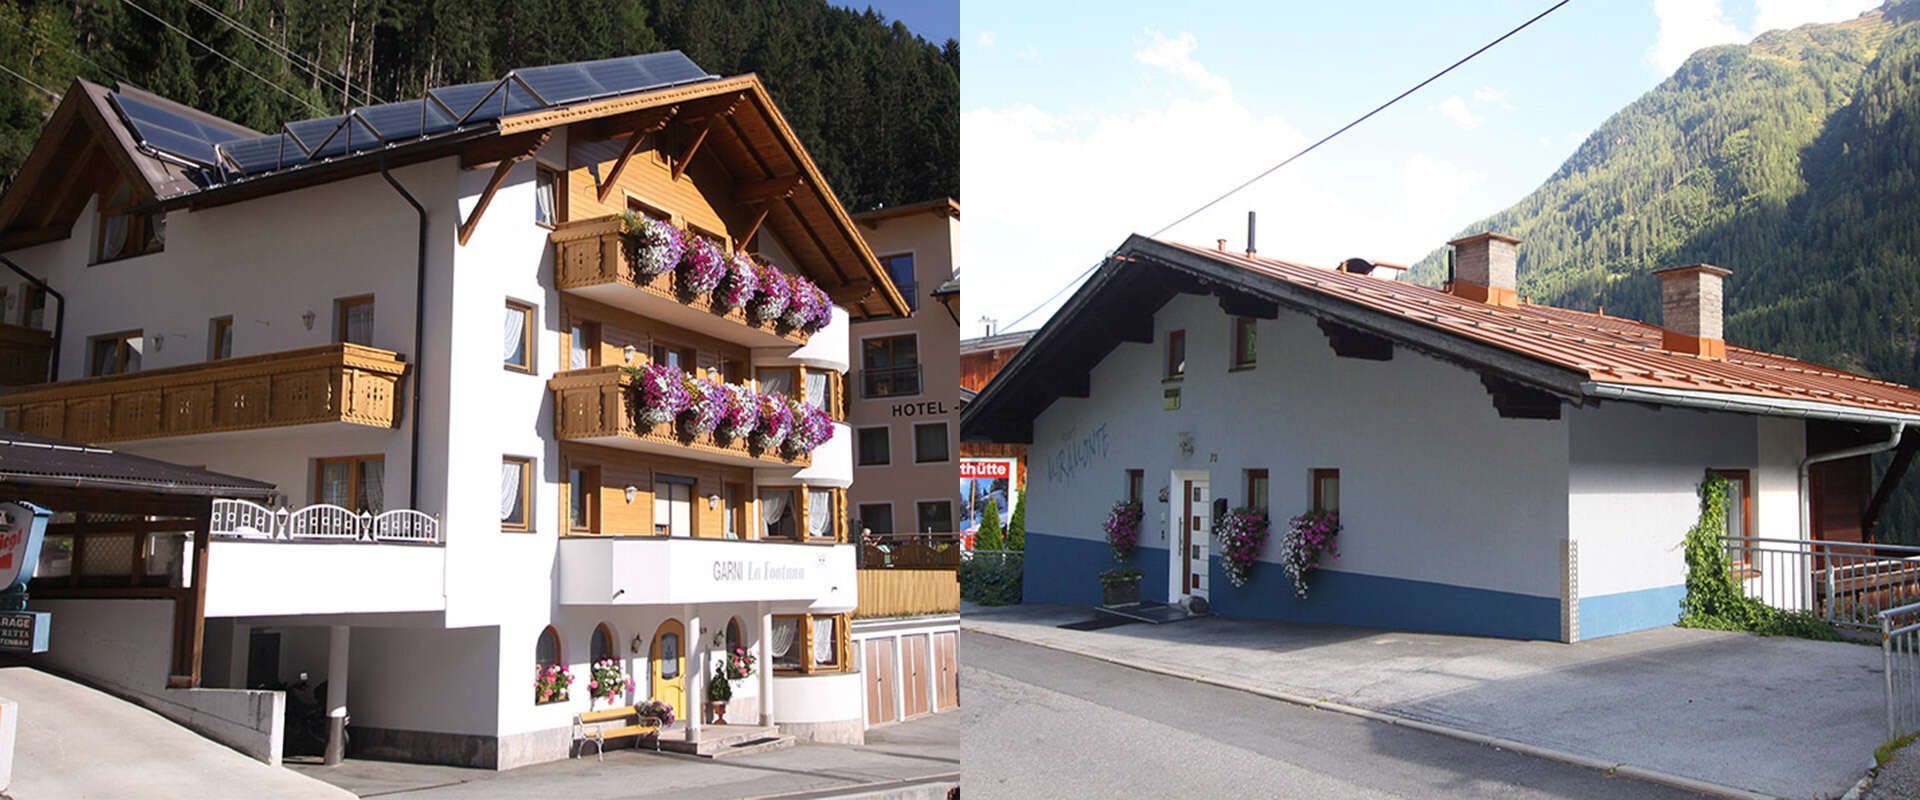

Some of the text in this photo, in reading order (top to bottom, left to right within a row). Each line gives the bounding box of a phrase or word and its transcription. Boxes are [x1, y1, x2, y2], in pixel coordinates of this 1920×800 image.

[892, 402, 948, 416] HOTEL
[713, 561, 743, 581] GARNI
[0, 617, 31, 628] RAGE
